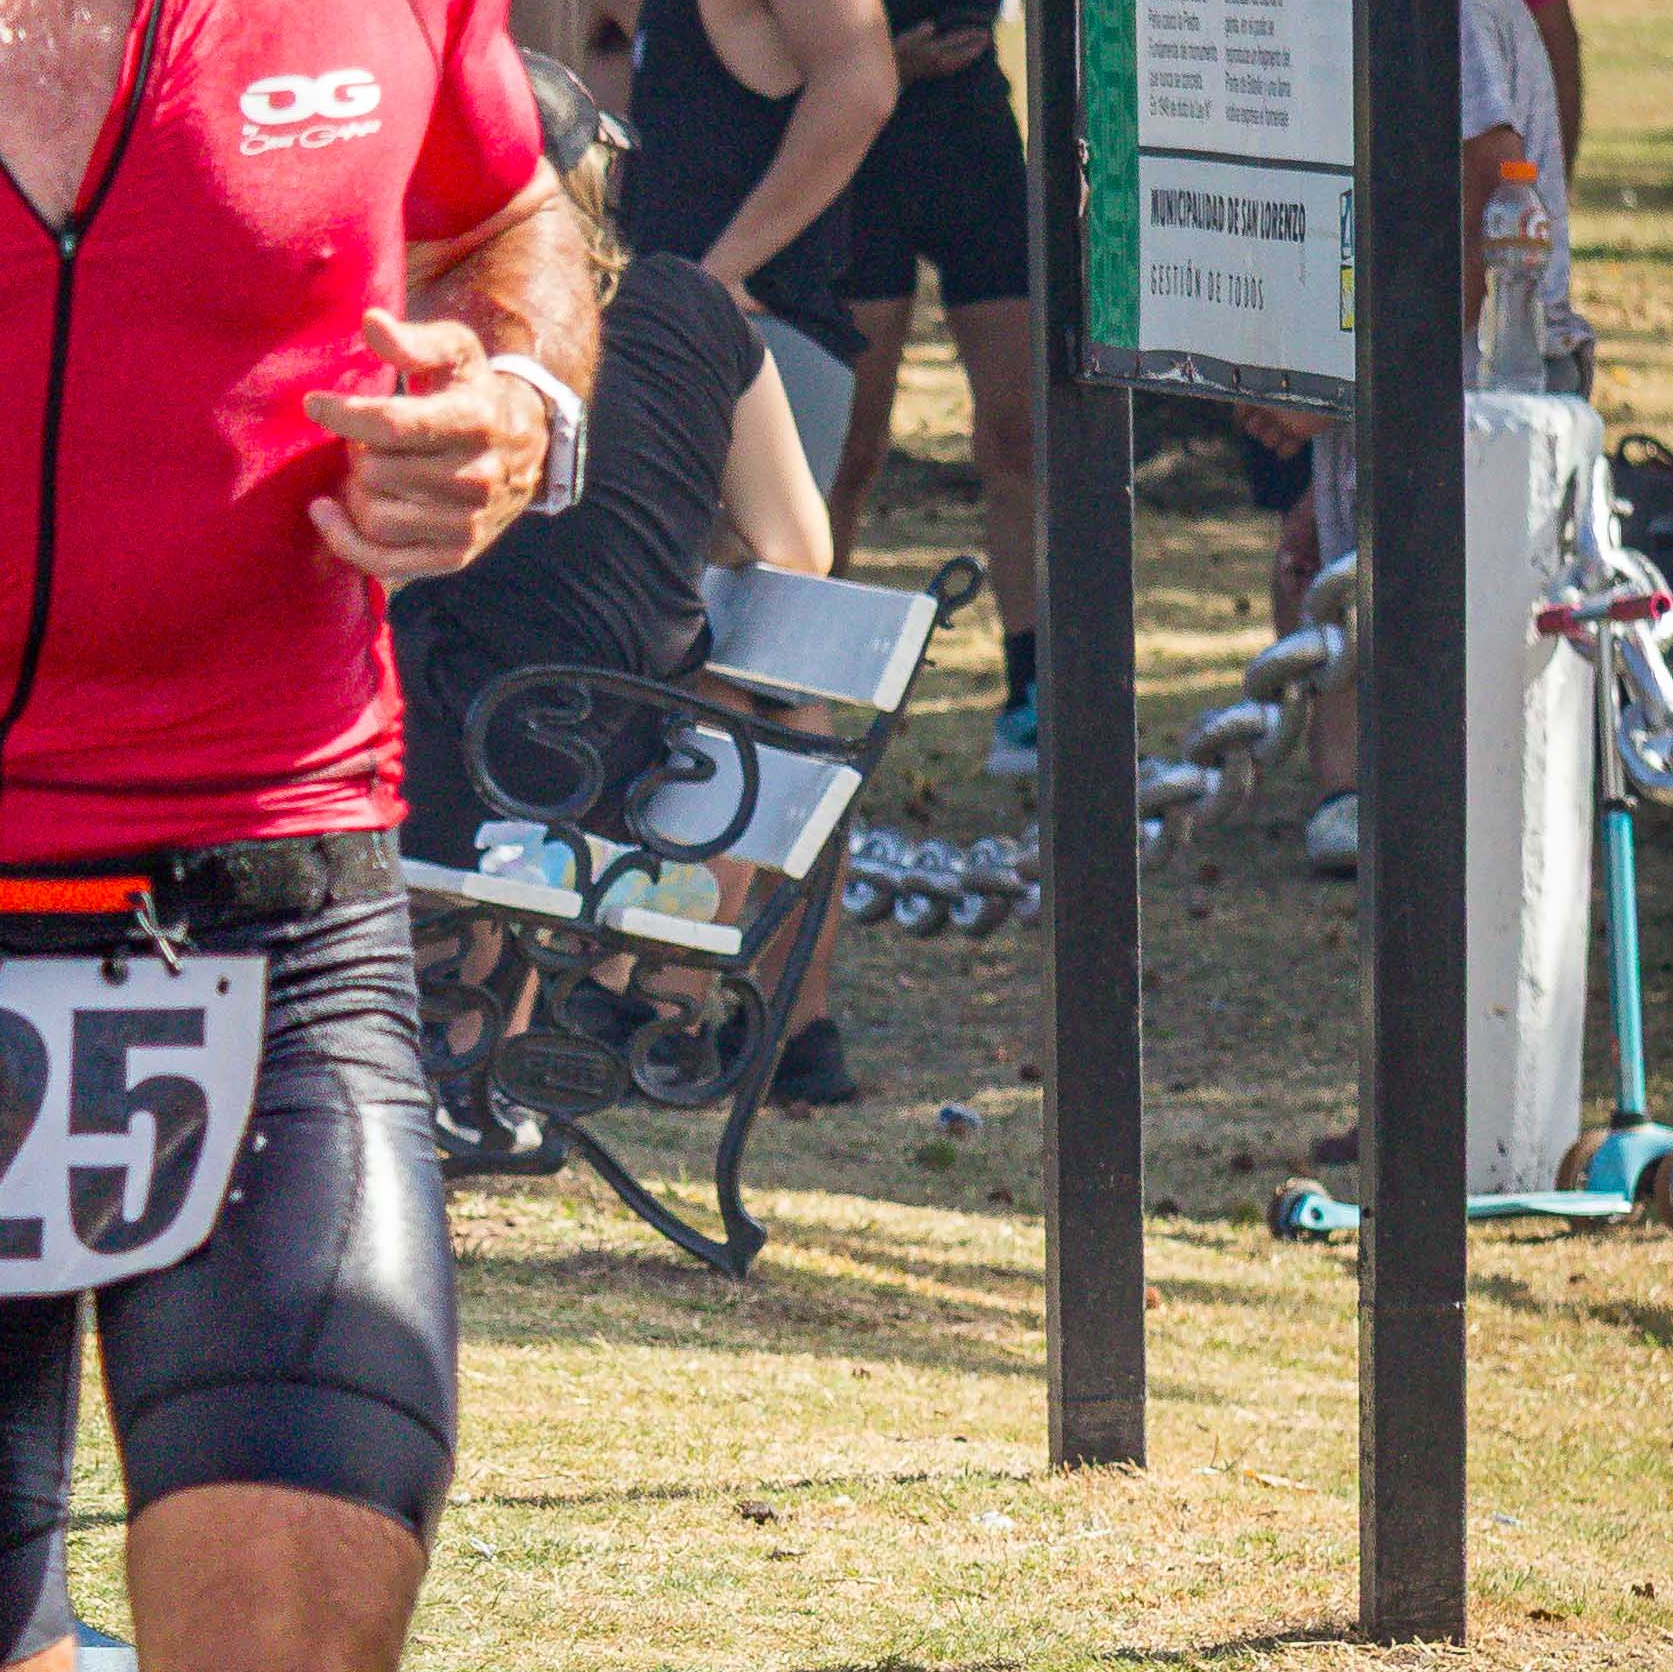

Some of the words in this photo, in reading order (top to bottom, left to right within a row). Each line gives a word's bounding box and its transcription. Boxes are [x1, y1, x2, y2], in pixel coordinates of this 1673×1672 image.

[1150, 188, 1225, 232] MUNICIPALIDAD
[1227, 197, 1239, 235] DE
[1242, 200, 1258, 239] SAN
[1260, 203, 1306, 243] LORENZO
[1150, 259, 1201, 297] GESTIÓN
[1208, 271, 1222, 303] DE
